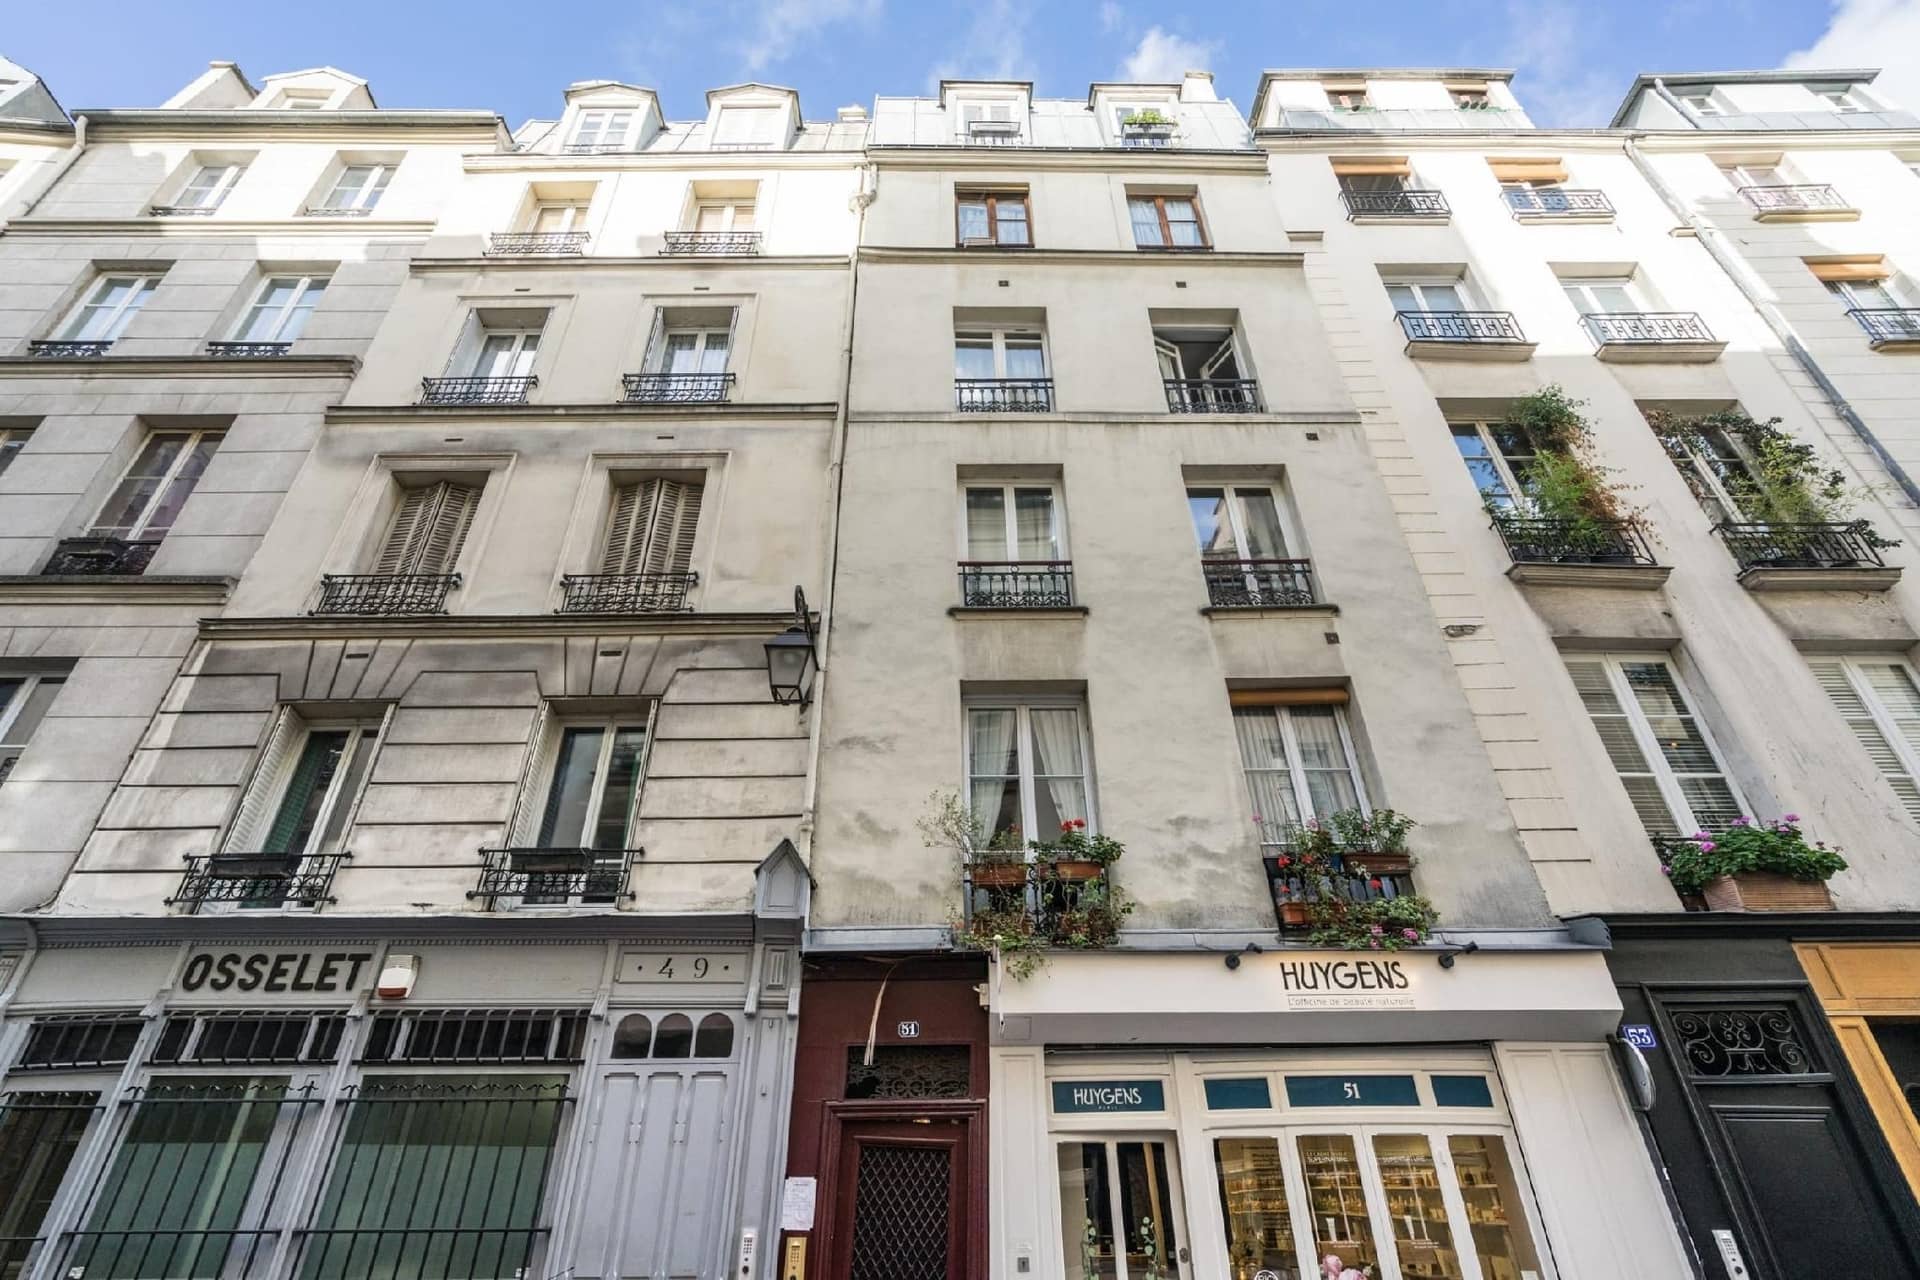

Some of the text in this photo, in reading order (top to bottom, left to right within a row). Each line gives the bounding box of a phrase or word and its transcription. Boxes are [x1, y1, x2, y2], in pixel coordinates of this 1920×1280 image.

[182, 953, 372, 992] OSSELET
[1279, 961, 1409, 990] HUYGENS
[901, 1023, 915, 1035] 51
[1628, 1028, 1650, 1045] 53
[1073, 1087, 1142, 1105] HUYGENS
[1344, 1082, 1360, 1099] 51
